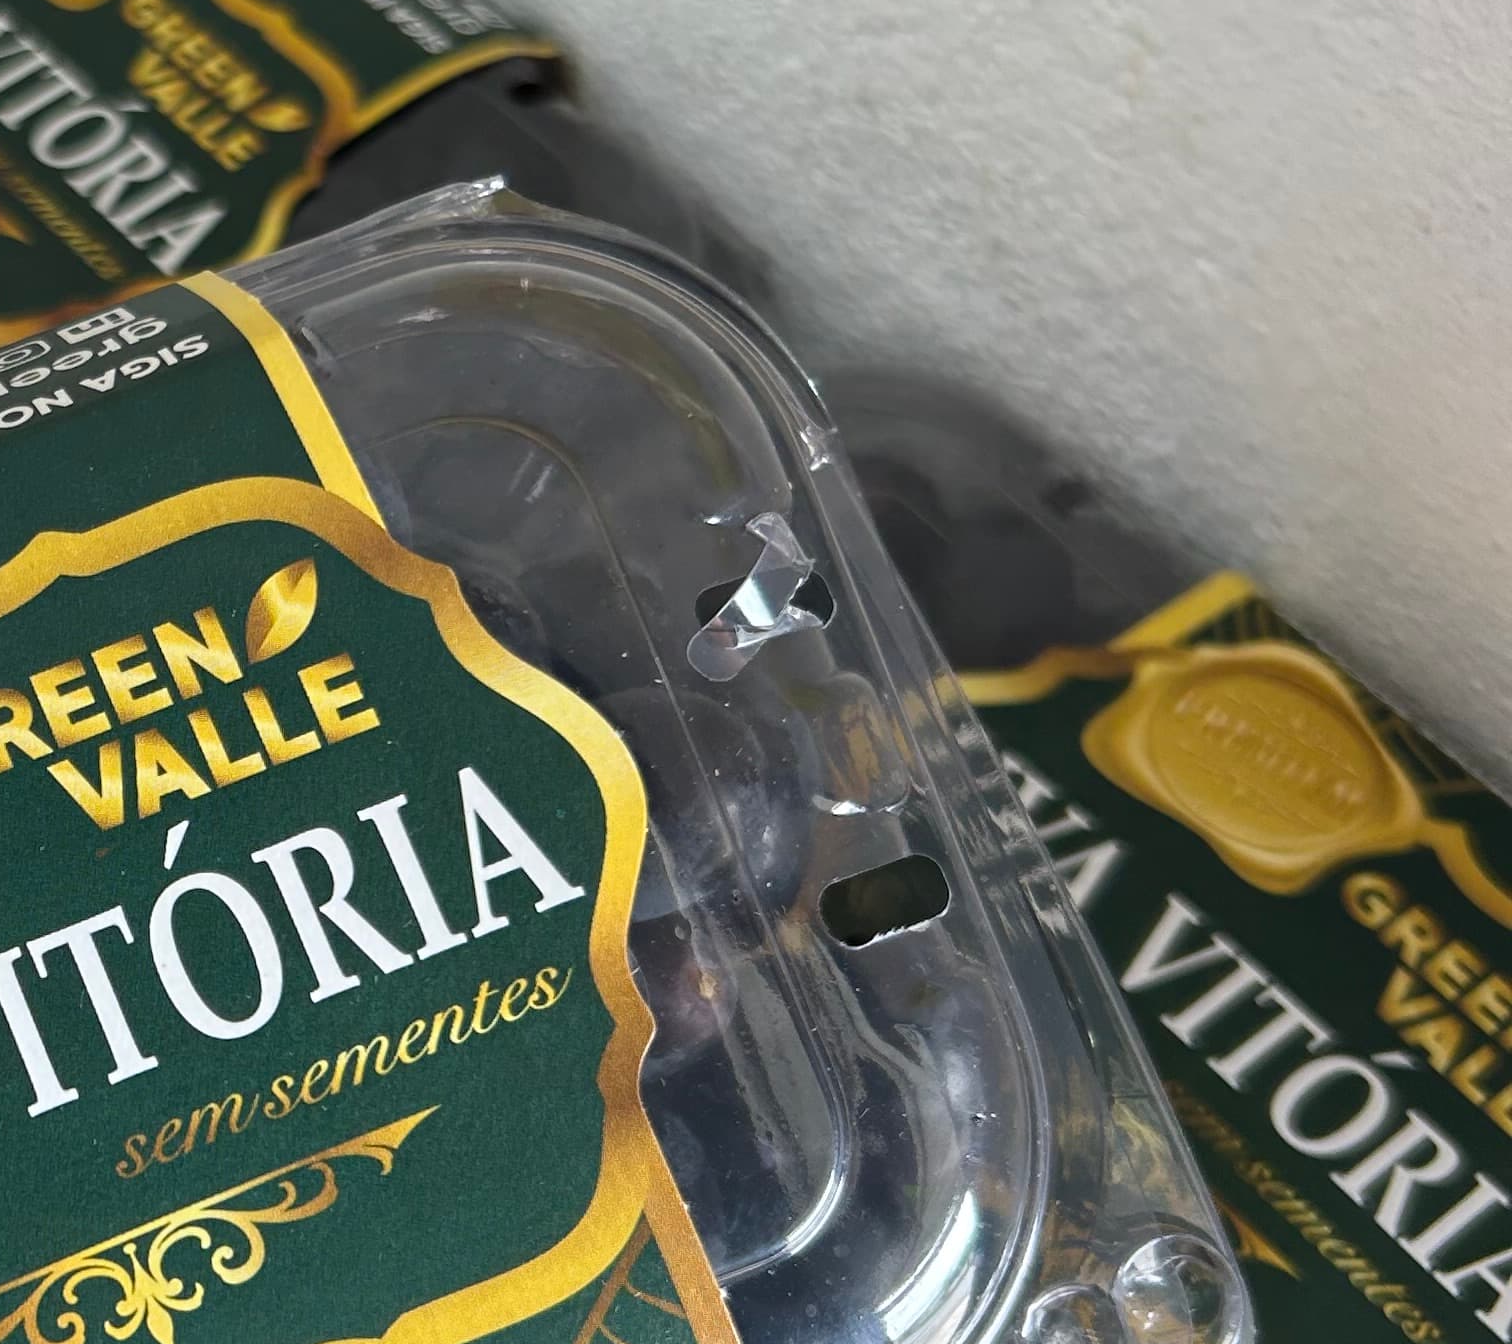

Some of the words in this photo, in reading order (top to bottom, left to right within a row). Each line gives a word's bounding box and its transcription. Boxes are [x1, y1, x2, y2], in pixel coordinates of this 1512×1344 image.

[129, 48, 261, 172] VALLE
[79, 333, 211, 393] SIGA
[47, 652, 381, 831] VALLE
[1340, 871, 1512, 1054] GREE
[115, 1091, 260, 1179] sem
[262, 965, 574, 1119] sementes
